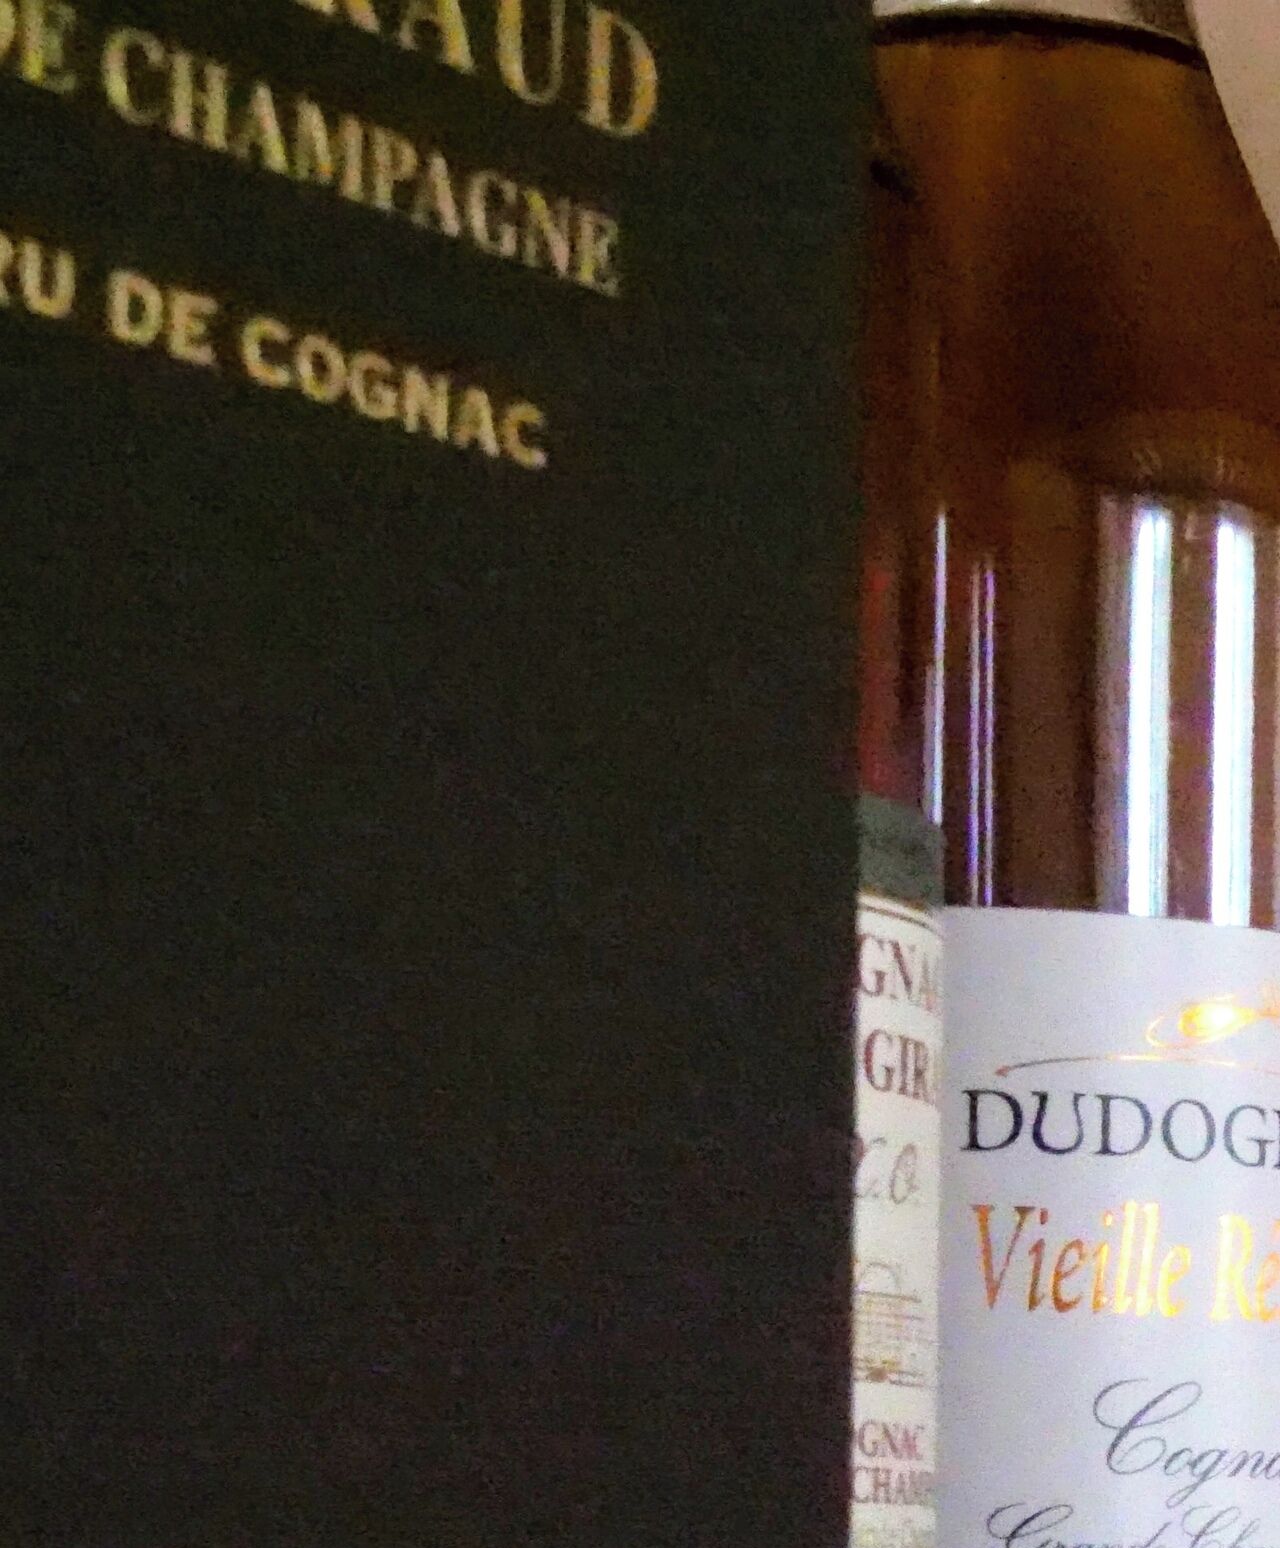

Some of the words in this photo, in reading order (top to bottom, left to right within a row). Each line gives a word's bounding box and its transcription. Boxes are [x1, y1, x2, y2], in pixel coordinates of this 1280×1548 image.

[0, 0, 78, 95] E
[100, 26, 623, 298] CHAMPAGNE
[298, 0, 660, 138] AUD
[0, 232, 77, 320] U
[107, 268, 220, 367] DE
[240, 317, 549, 469] COGNAC
[972, 1200, 1192, 1318] Vieille
